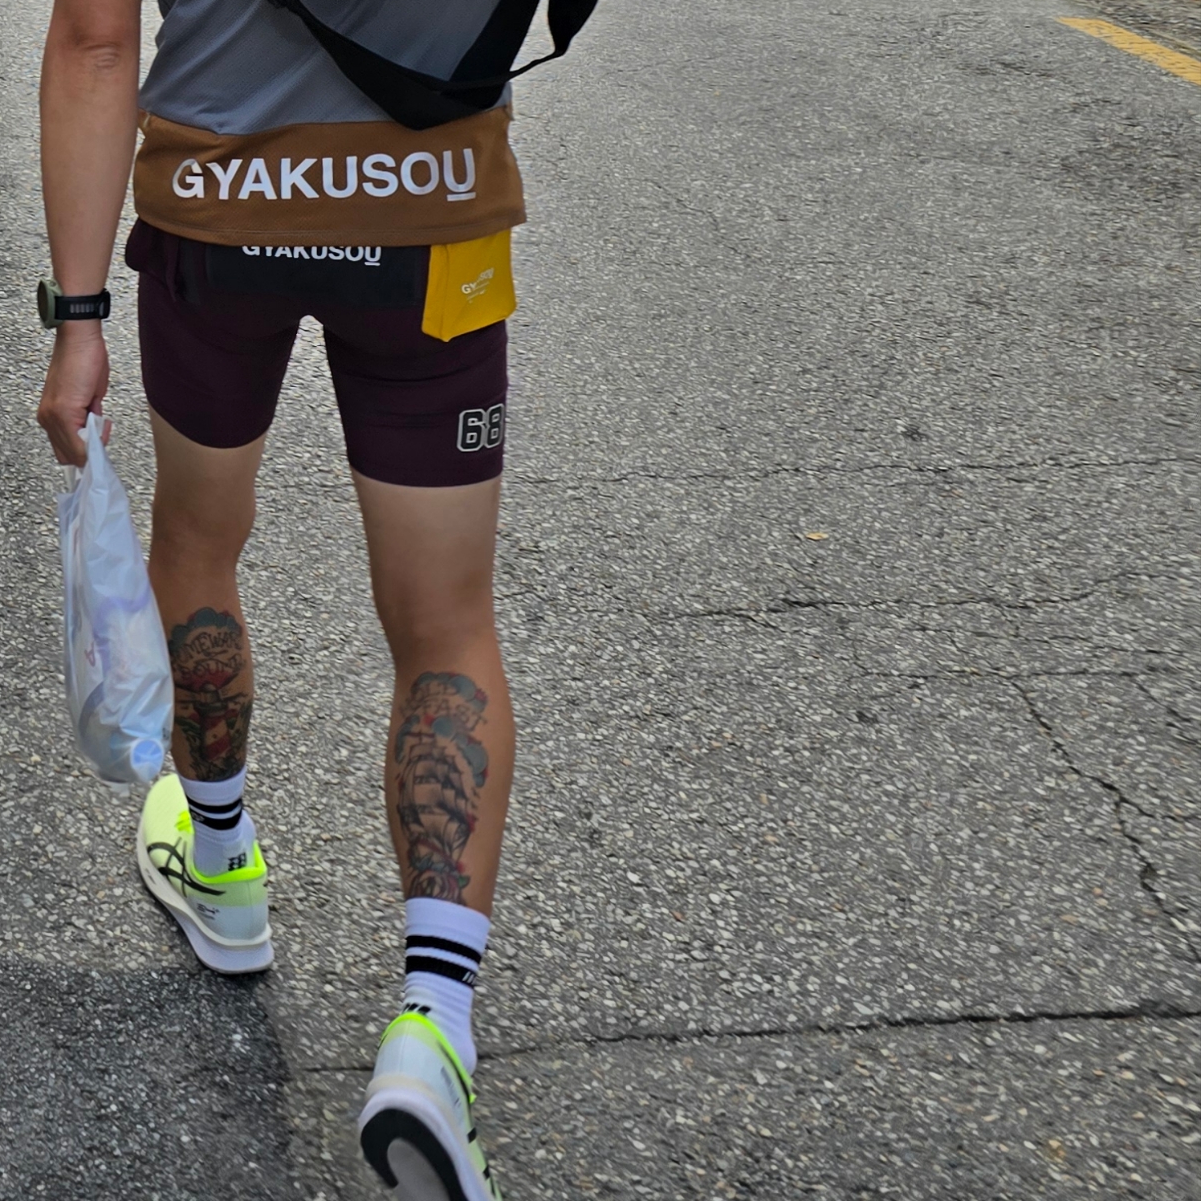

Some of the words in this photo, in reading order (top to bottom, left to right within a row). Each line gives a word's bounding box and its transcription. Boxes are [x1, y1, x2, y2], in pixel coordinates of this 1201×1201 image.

[171, 147, 477, 203] GYAKUSOU
[241, 245, 382, 267] GYAKUSOU
[456, 402, 505, 453] 68
